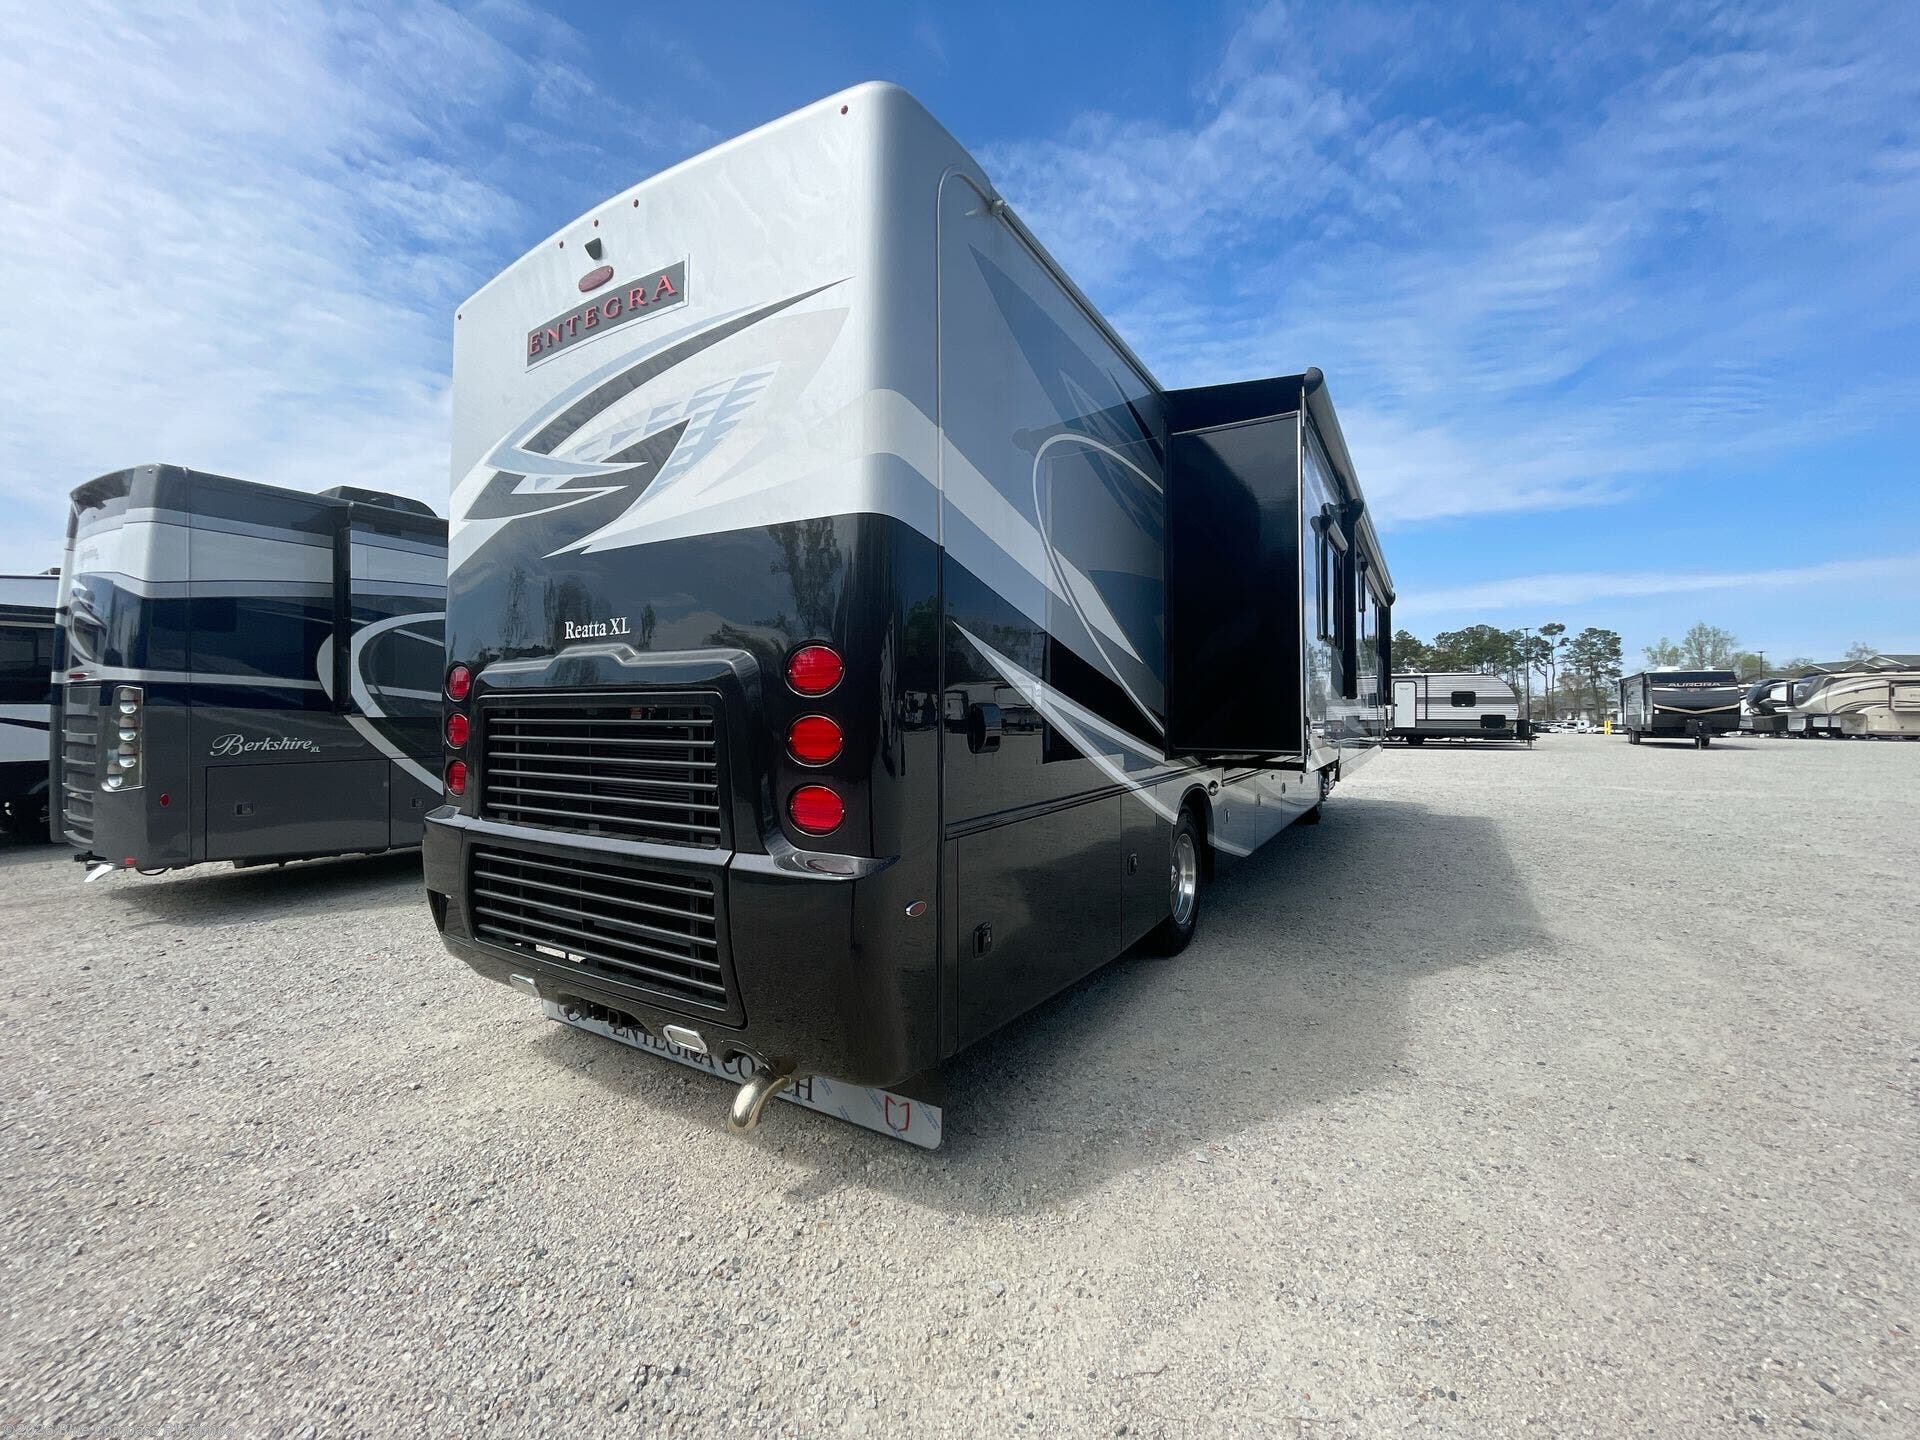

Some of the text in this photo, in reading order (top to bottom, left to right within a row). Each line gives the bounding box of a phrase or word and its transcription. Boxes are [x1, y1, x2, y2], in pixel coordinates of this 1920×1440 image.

[528, 274, 677, 356] ENTEGRA
[564, 616, 631, 640] Reatta XL
[209, 733, 313, 756] Berkshire
